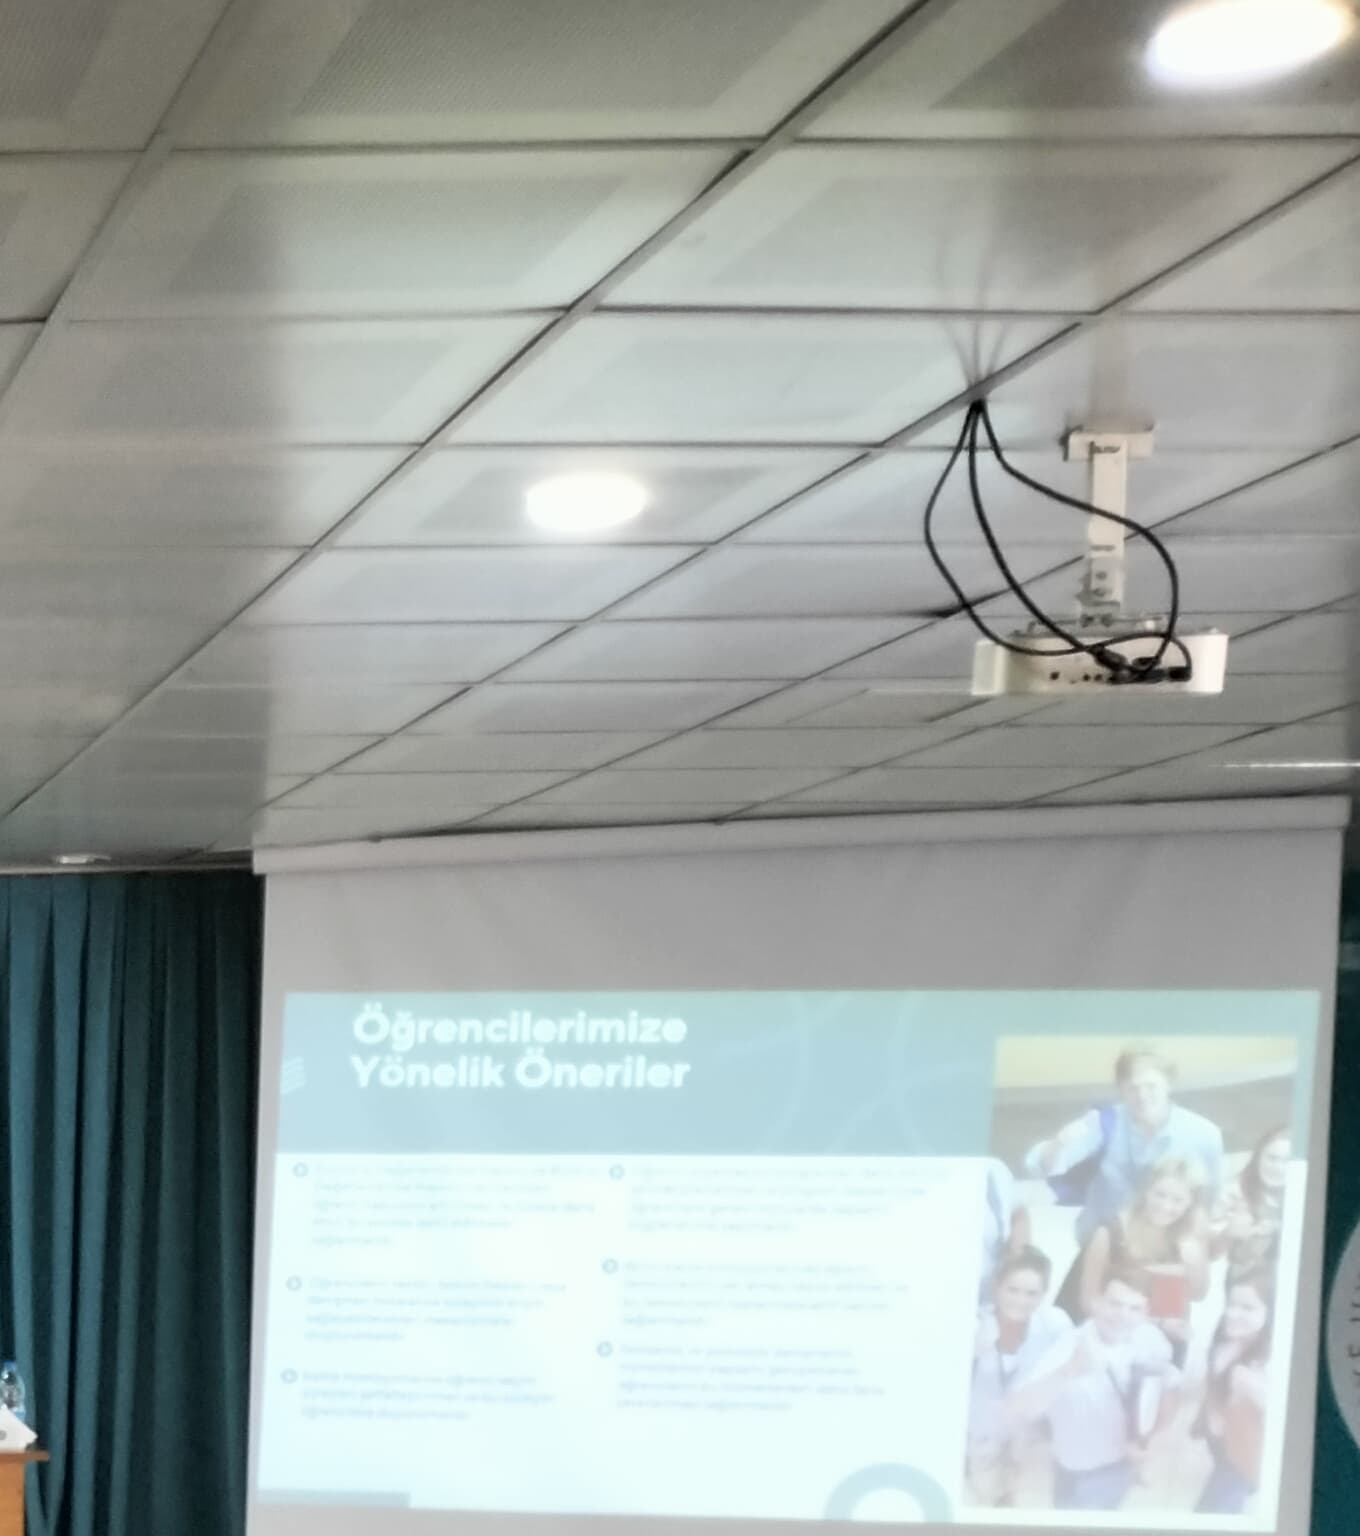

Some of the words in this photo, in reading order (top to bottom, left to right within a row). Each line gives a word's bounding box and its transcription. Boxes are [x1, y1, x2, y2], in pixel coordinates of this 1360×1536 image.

[353, 1002, 688, 1051] Öğrencilerimize
[350, 1055, 505, 1089] Yönelik
[515, 1047, 691, 1089] Öneriler
